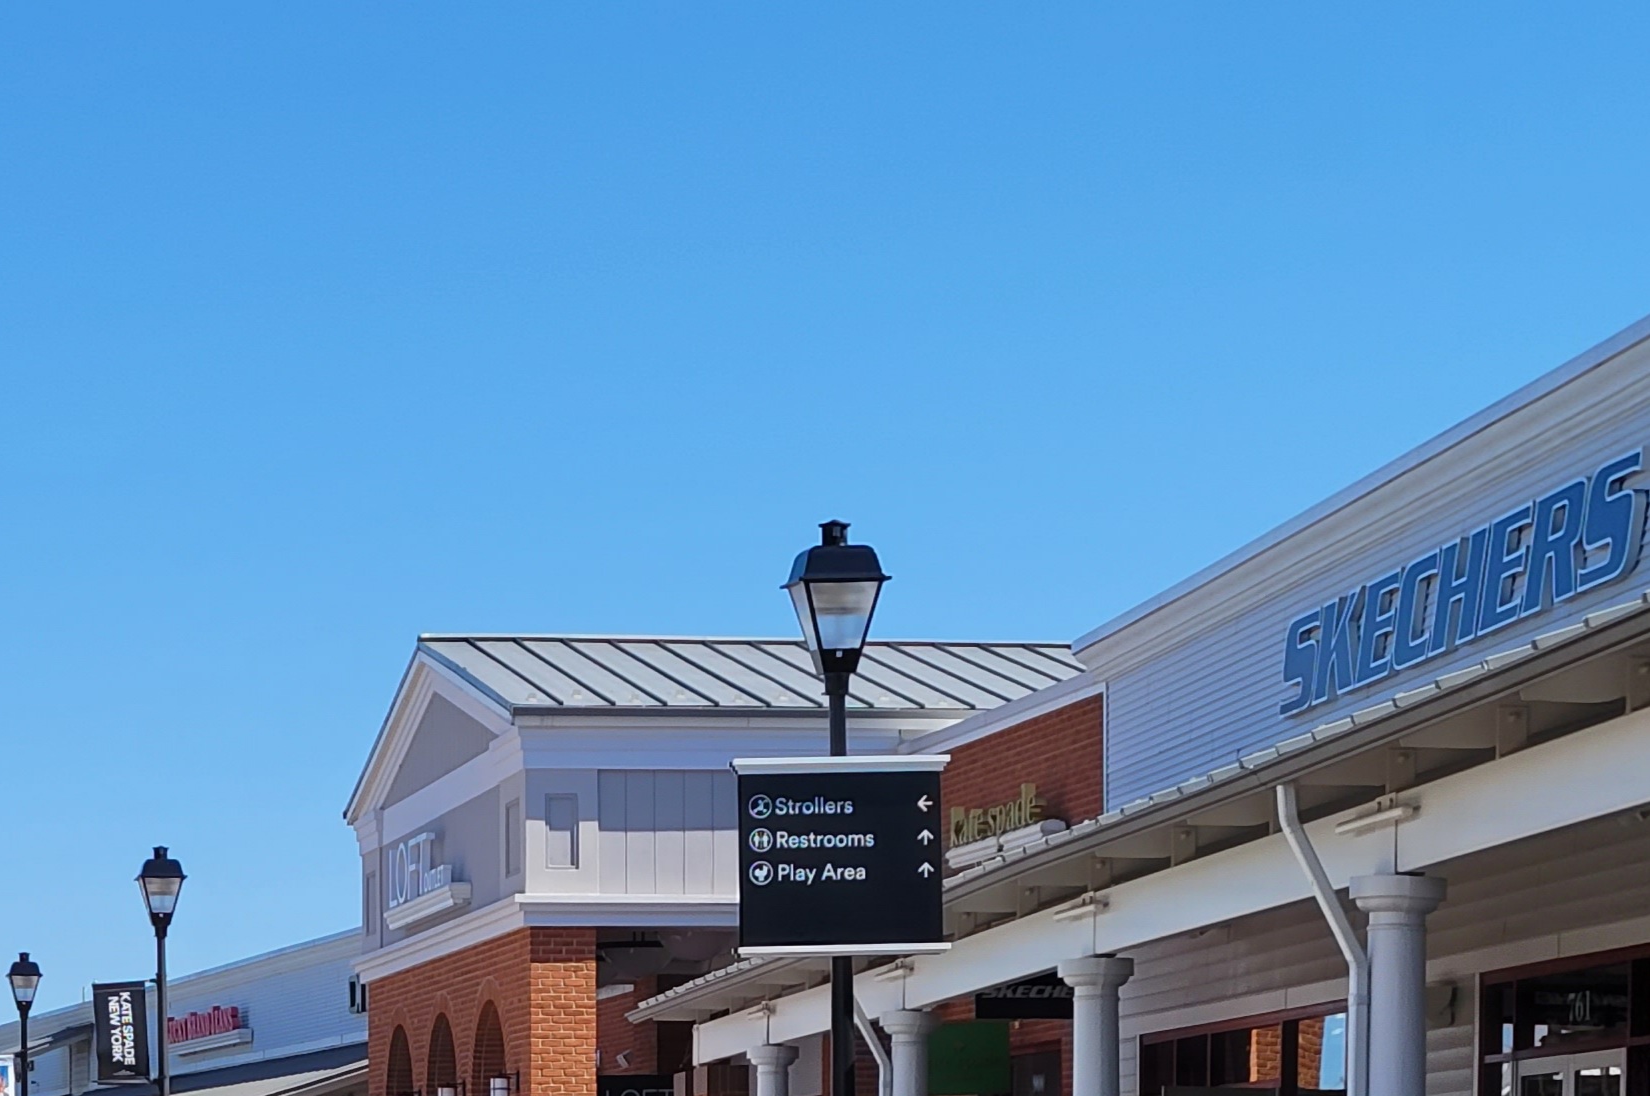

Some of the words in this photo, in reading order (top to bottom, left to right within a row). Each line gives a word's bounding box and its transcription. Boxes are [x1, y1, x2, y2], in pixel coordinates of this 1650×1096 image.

[1279, 446, 1645, 719] SKECHERS
[775, 797, 854, 816] Strollers
[987, 783, 1047, 847] spade
[776, 831, 875, 849] Restrooms
[389, 832, 435, 908] LOFT
[778, 864, 817, 885] Play
[821, 863, 867, 881] Area
[119, 991, 134, 1024] KATE
[982, 985, 1074, 999] SKECHE
[107, 996, 121, 1026] NEW
[110, 1027, 124, 1063] YORK
[122, 1025, 136, 1066] SPADE
